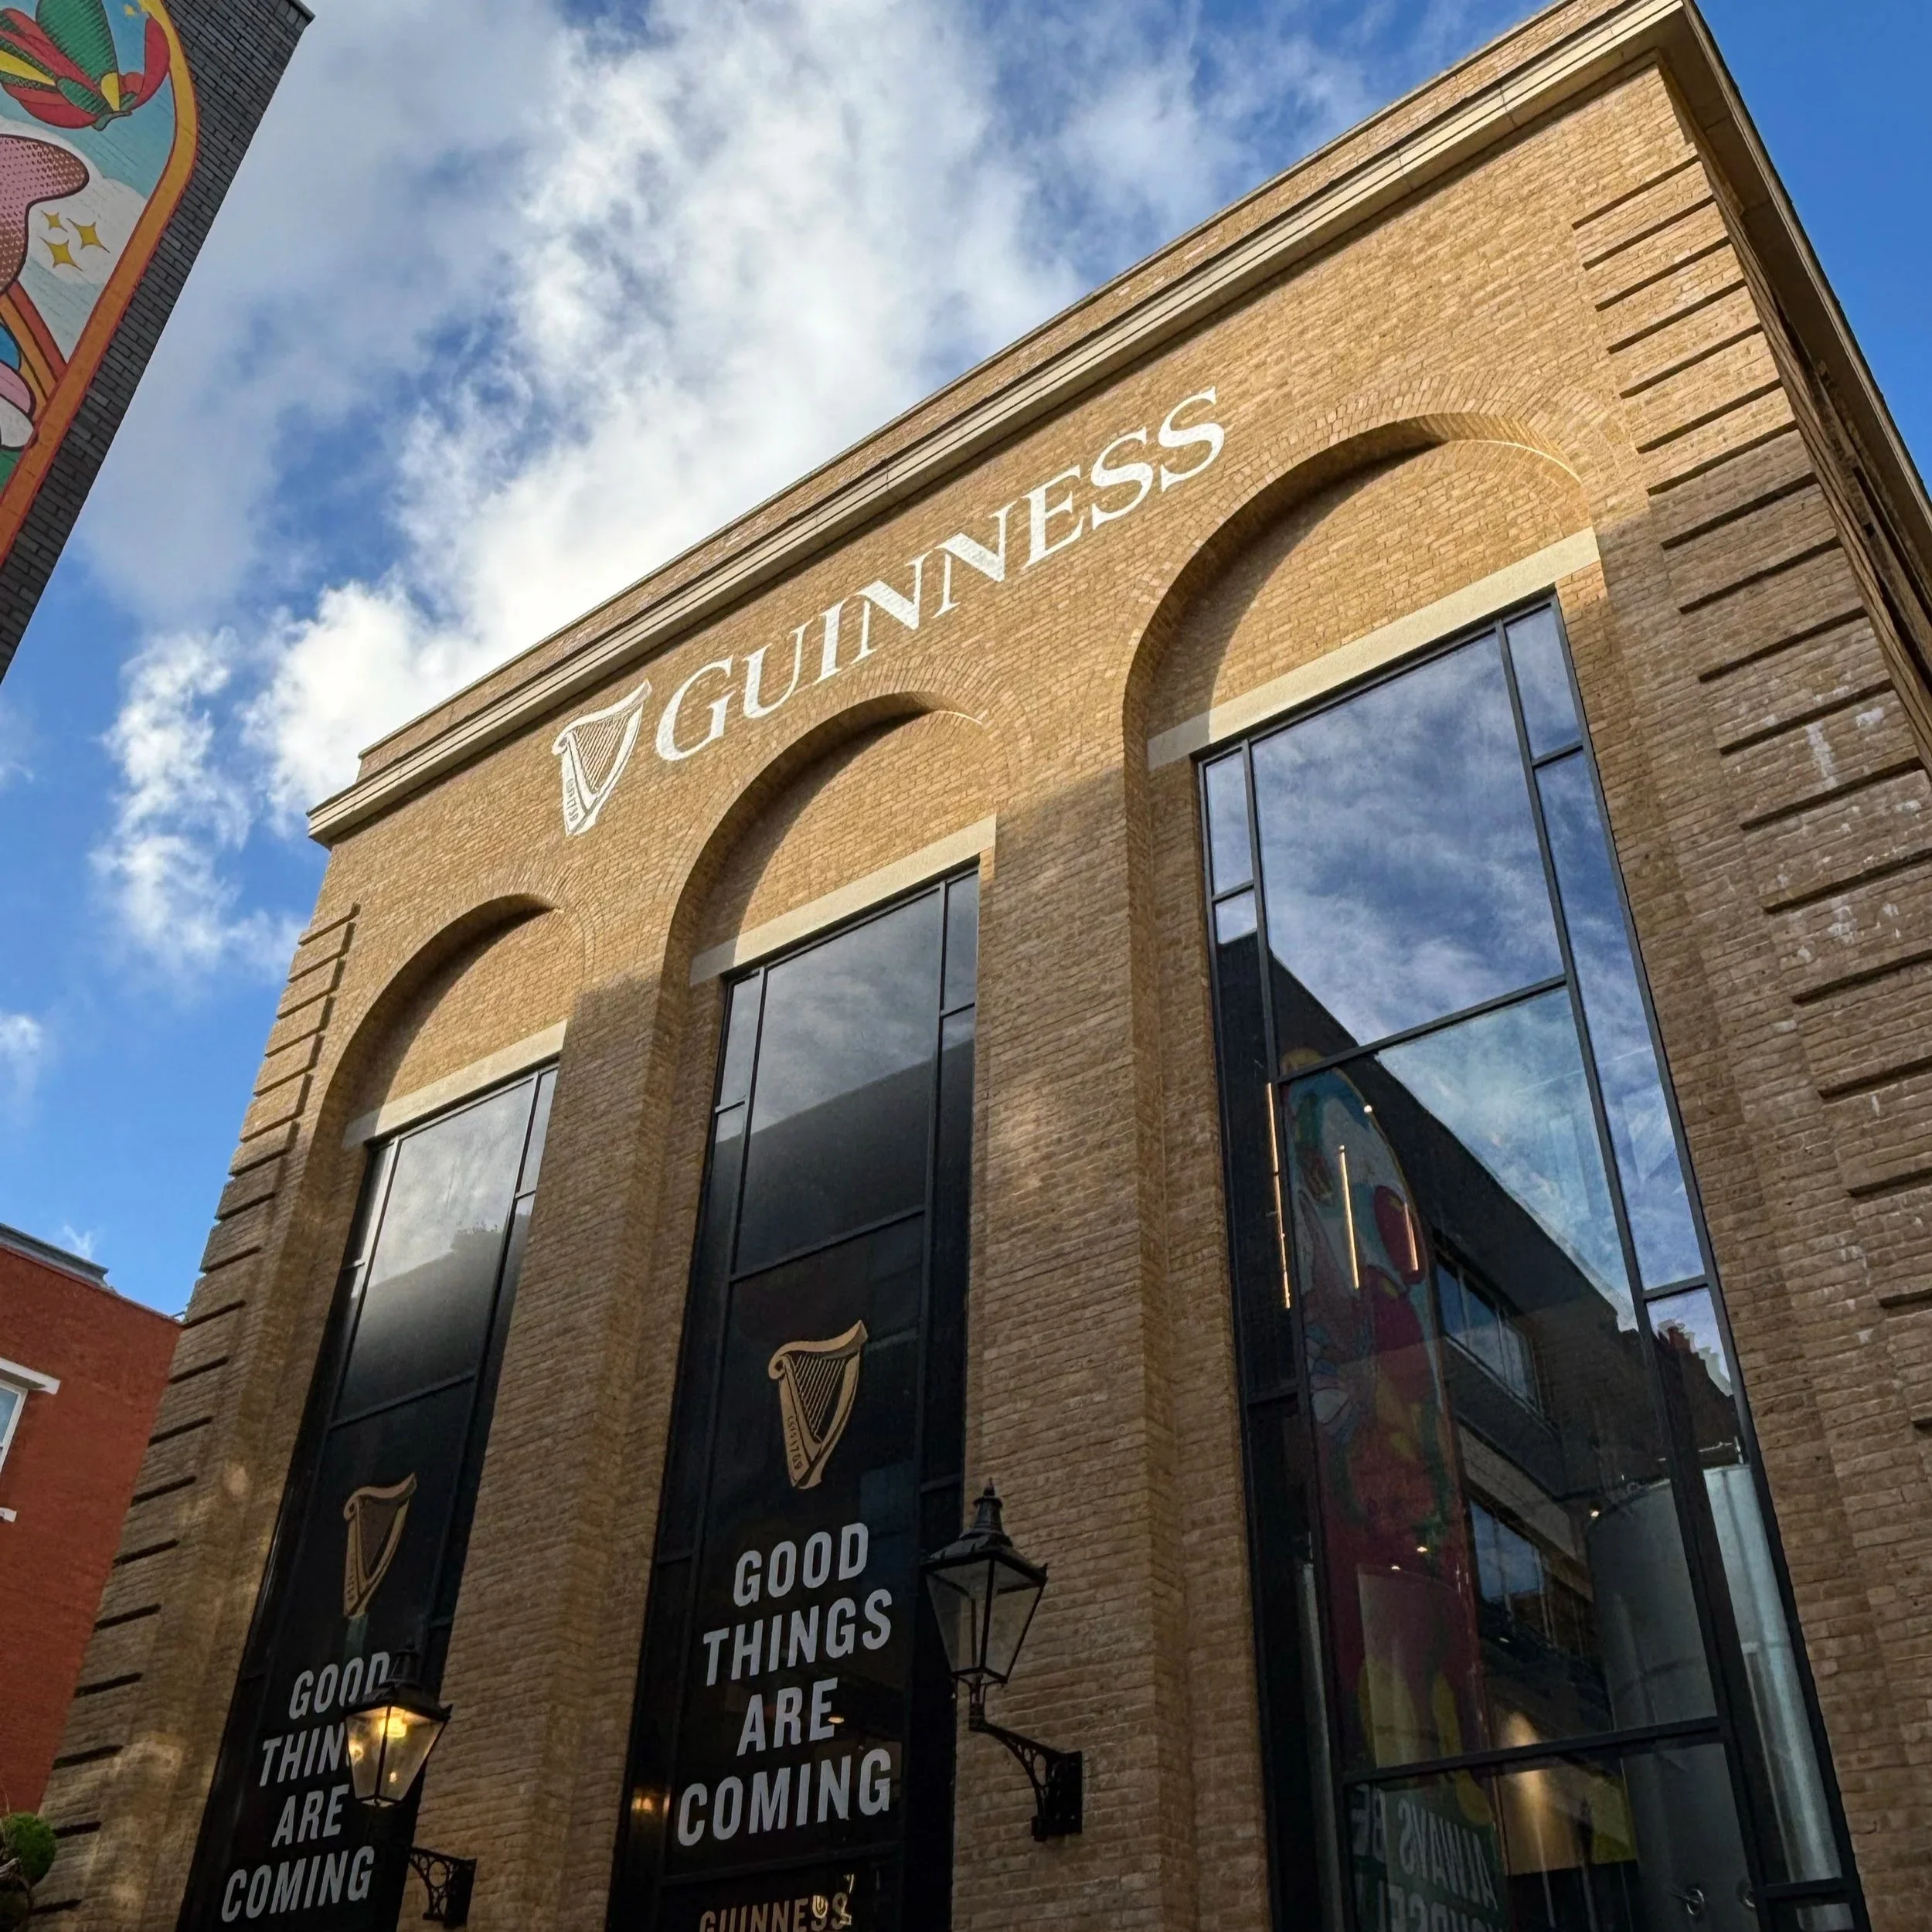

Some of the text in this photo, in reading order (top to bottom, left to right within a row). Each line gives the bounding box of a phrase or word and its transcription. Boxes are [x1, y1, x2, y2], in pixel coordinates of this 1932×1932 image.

[655, 386, 1226, 763] GUINNESS
[734, 1522, 869, 1607] GOOD
[703, 1589, 893, 1686] THINGS
[289, 1651, 390, 1719] GOOD
[736, 1677, 838, 1756] ARE
[260, 1722, 350, 1787] THIN
[272, 1784, 349, 1847] ARE
[678, 1748, 891, 1846] COMING
[221, 1845, 375, 1923] COMING
